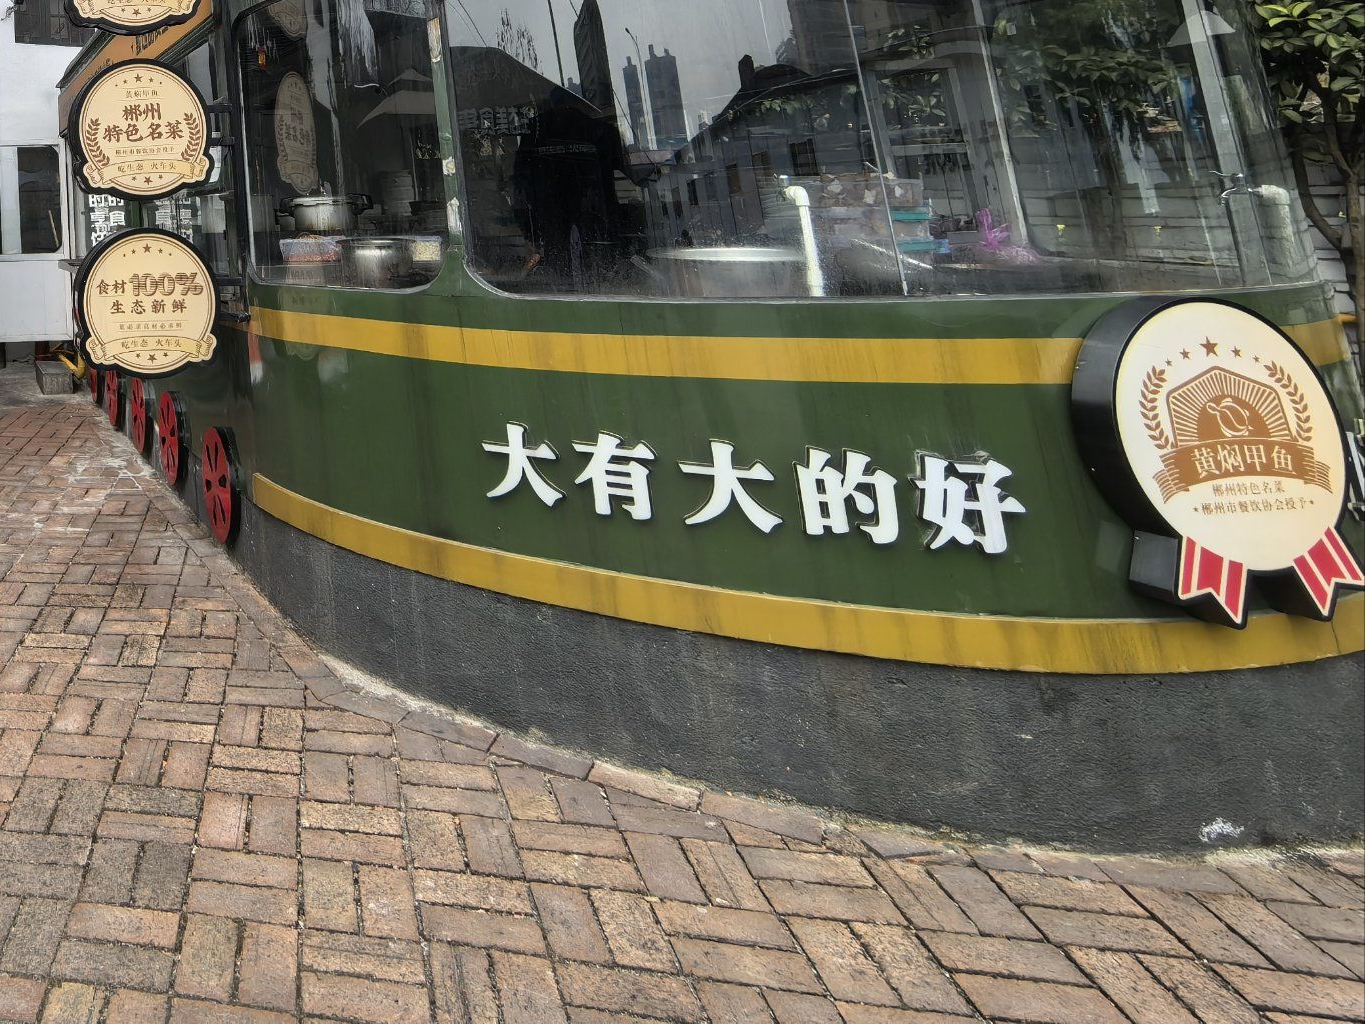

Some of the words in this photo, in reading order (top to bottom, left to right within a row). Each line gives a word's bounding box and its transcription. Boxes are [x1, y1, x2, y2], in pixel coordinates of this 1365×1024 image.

[122, 102, 161, 122] 郴州
[102, 120, 184, 143] 特色名菜
[96, 279, 127, 294] 食材
[129, 272, 203, 296] 100%
[110, 299, 187, 314] 生态新鲜
[1190, 444, 1297, 478] 黄焖甲鱼
[481, 420, 1027, 555] 大有大的好
[1212, 480, 1285, 497] 郴州特色名菜
[1201, 497, 1307, 515] 郴州市餐饮协会授予
